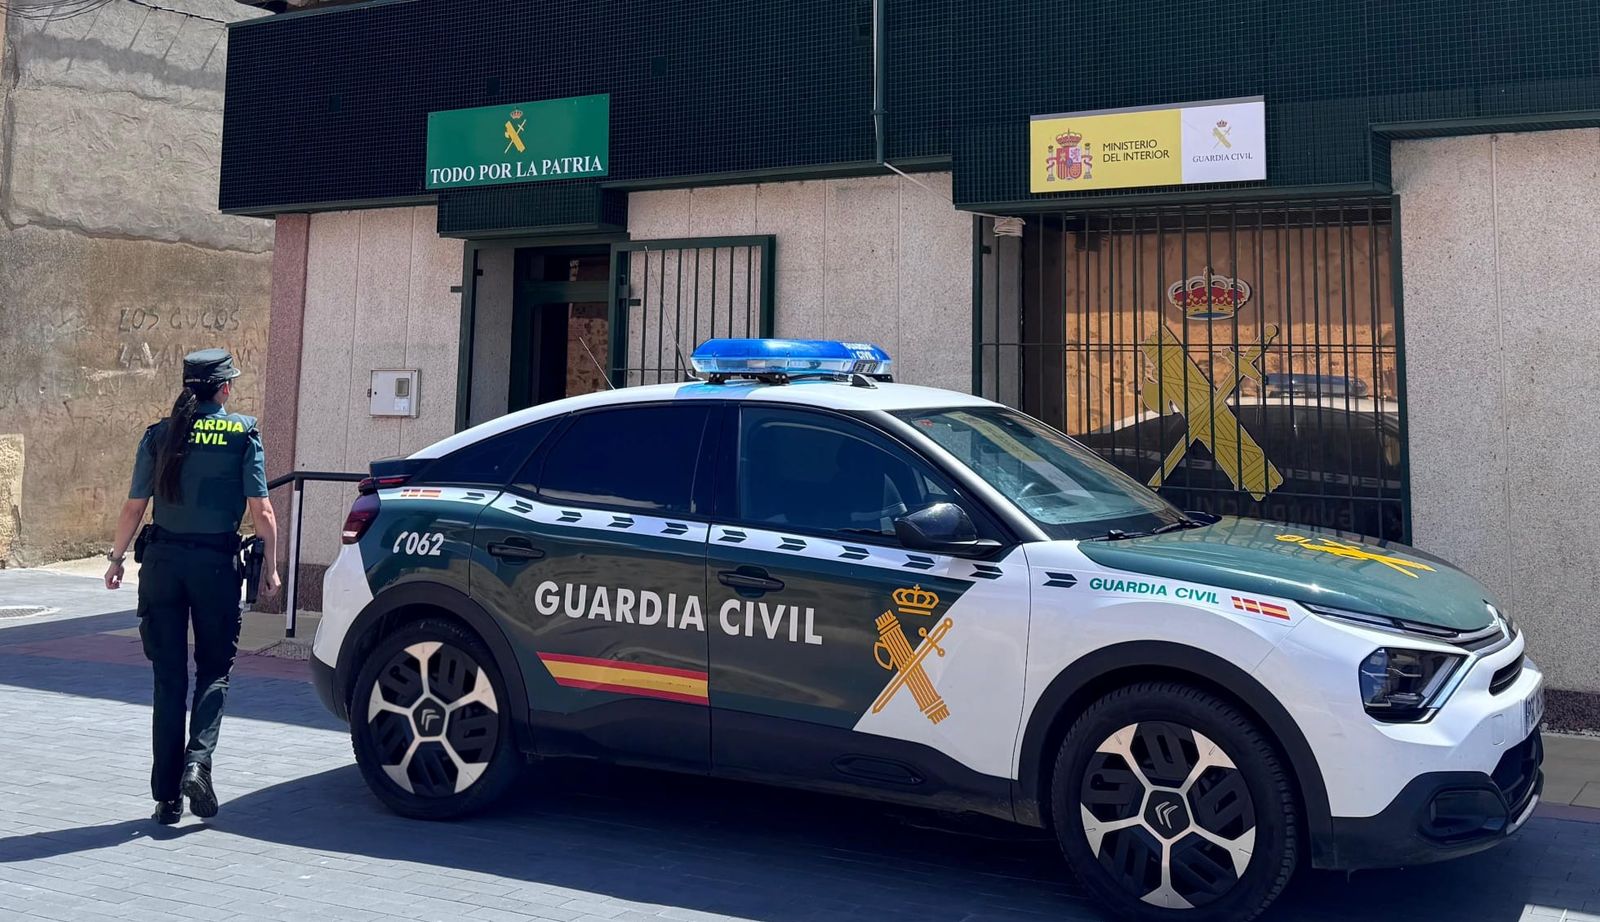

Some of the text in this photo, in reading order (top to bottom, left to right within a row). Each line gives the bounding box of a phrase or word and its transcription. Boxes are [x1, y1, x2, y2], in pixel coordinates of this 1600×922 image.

[1102, 139, 1158, 152] MINISTERIO
[1102, 149, 1170, 163] DEL INTERIOR
[1192, 152, 1253, 163] GUARDIA CIVIL
[430, 155, 602, 184] TODO POR LA PATRIA
[193, 418, 244, 433] ARDIA
[405, 531, 445, 556] 062
[1089, 577, 1220, 605] GUARDIA CIVIL
[534, 580, 824, 646] GUARDIA CIVIL
